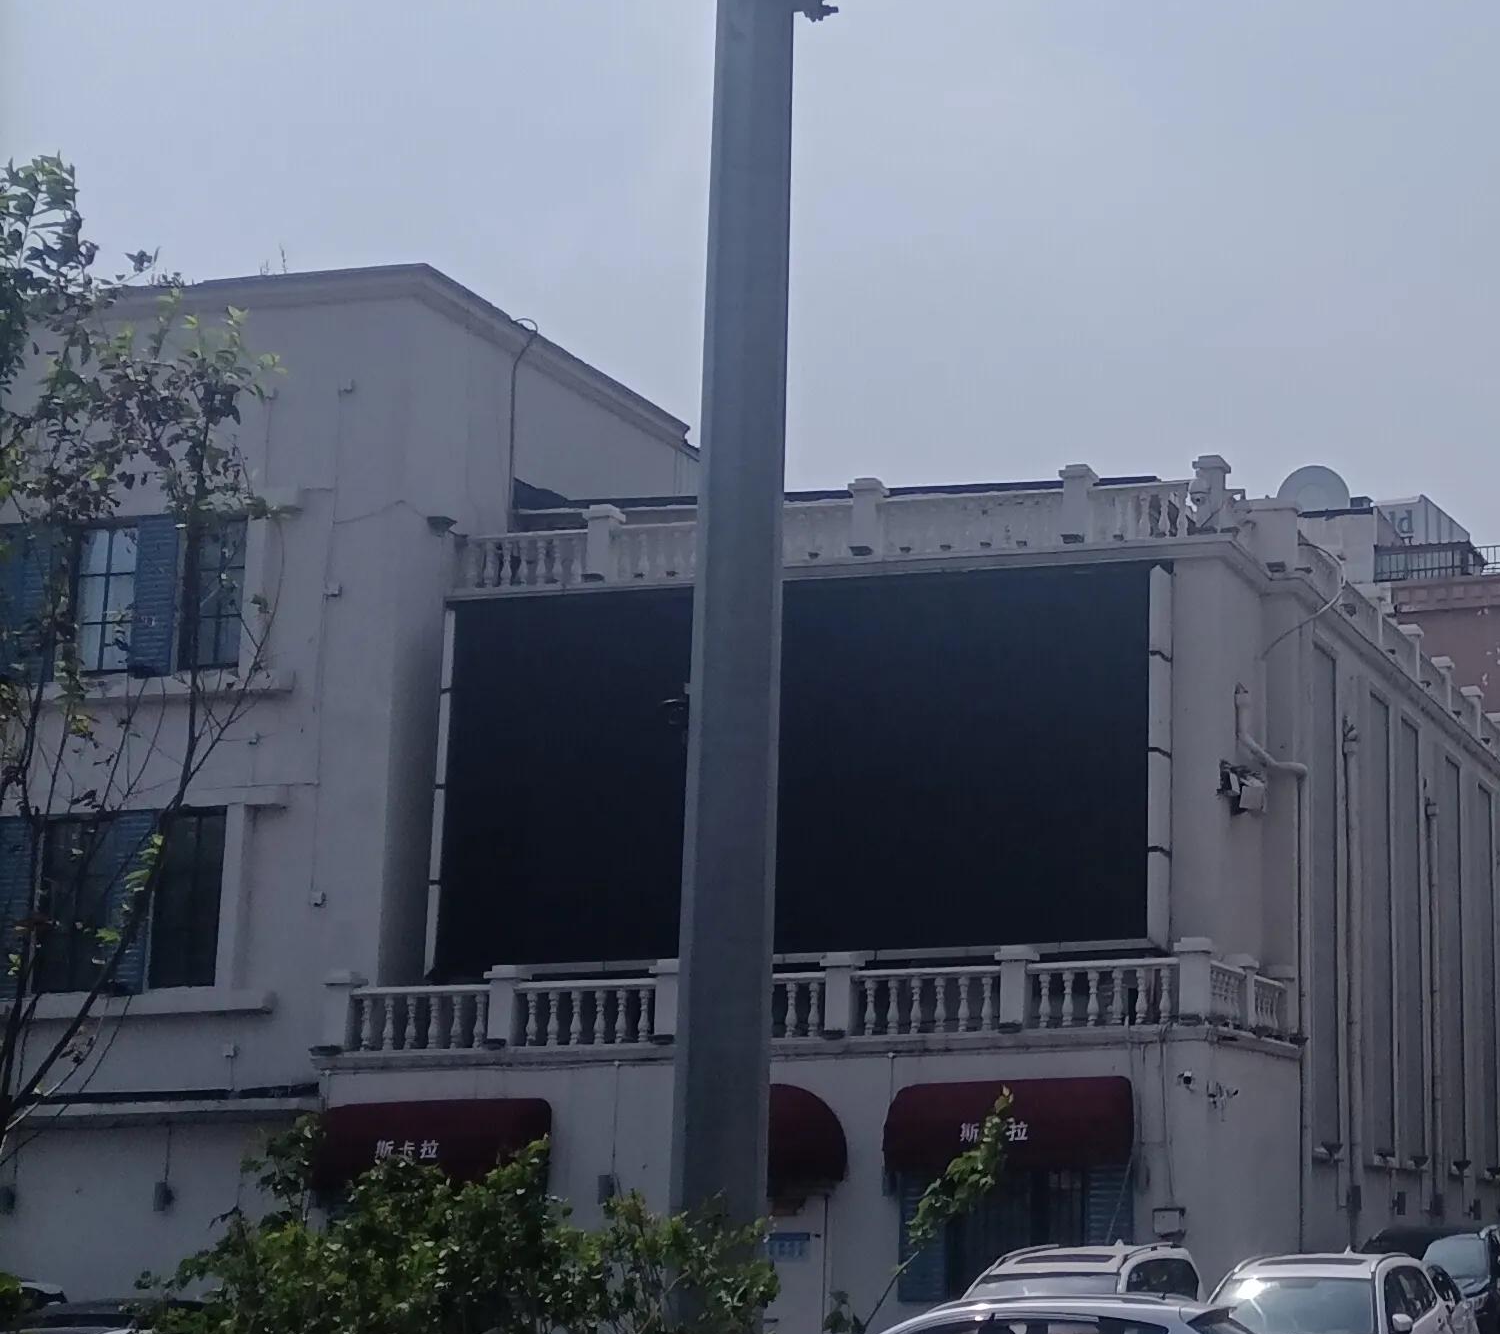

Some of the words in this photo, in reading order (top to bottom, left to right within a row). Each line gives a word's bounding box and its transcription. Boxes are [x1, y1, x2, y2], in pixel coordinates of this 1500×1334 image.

[960, 1121, 1029, 1143] 斯拉
[375, 1139, 440, 1160] 斯卡拉
